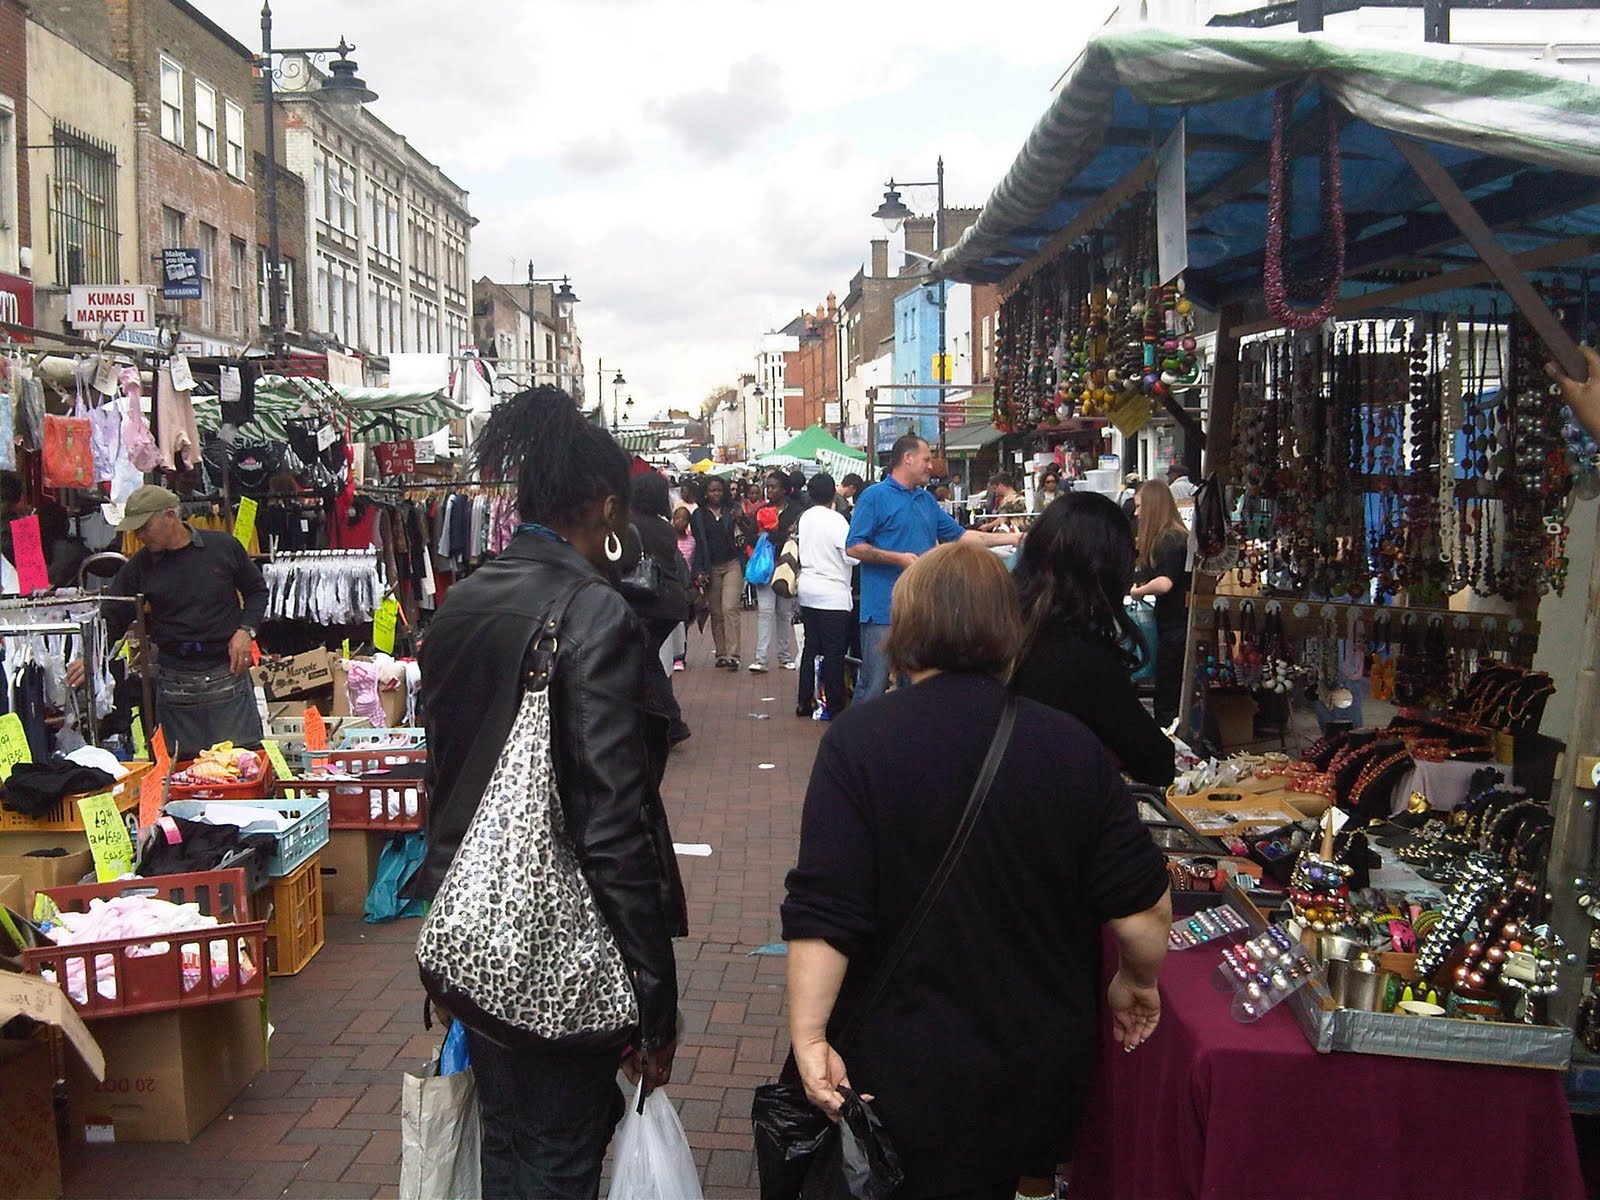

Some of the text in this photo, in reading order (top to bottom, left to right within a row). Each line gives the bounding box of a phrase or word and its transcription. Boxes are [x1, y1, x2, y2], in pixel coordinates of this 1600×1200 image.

[165, 250, 187, 258] Makes
[165, 256, 197, 265] you think
[164, 288, 200, 296] NEWSAGENTS
[88, 293, 135, 306] KUMASI
[77, 309, 145, 323] MARKET II
[385, 459, 393, 473] 2
[135, 1078, 156, 1092] 20
